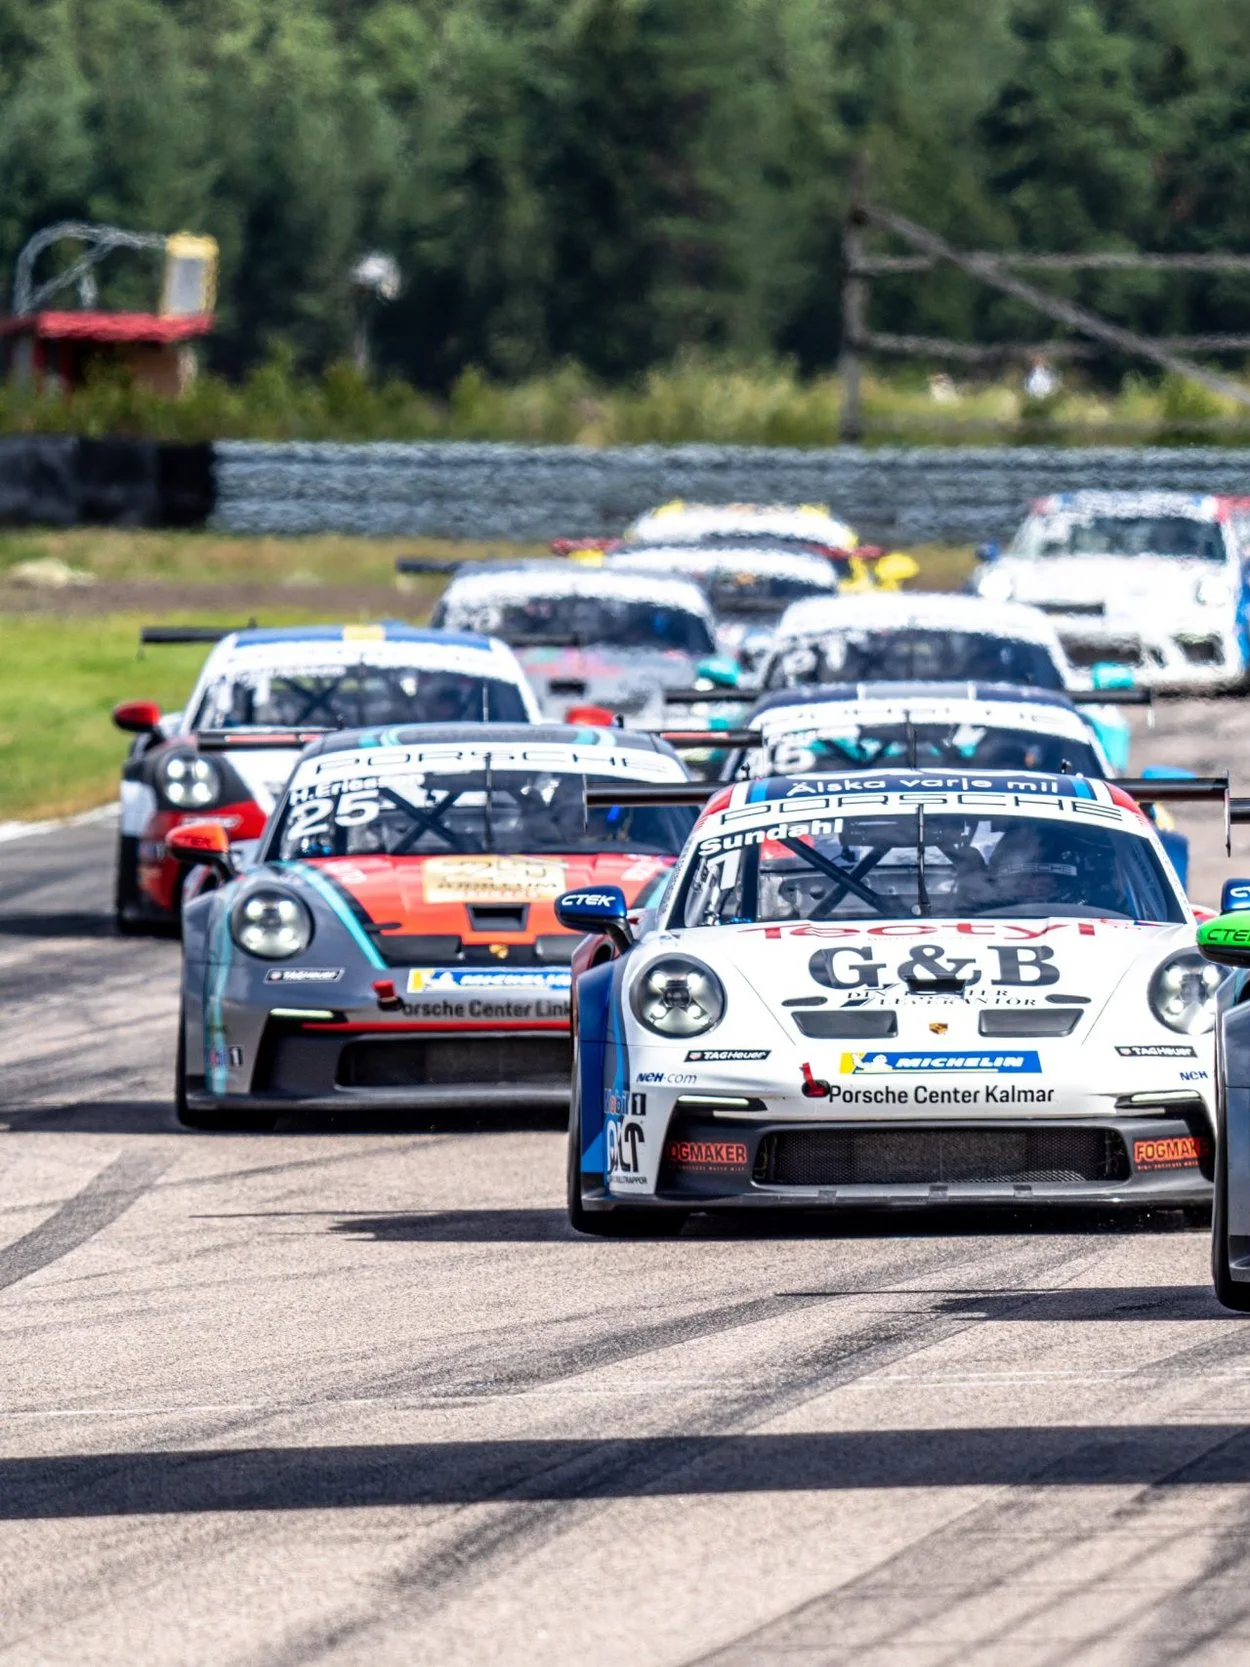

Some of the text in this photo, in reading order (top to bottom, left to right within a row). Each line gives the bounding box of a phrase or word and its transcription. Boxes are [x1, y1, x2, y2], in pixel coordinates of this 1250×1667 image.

[786, 776, 1058, 797] Älska varje mil
[288, 789, 380, 840] 25
[720, 792, 1121, 826] PORSCHE
[698, 818, 844, 856] Sundahl
[707, 849, 742, 891] 1
[561, 894, 616, 907] CTEK
[808, 943, 1061, 990] G&B
[468, 999, 533, 1018] Center
[535, 999, 571, 1017] Link
[895, 1056, 1025, 1068] MICHELIN
[828, 1084, 1055, 1104] Porsche Center Kalmar
[670, 1143, 746, 1163] OGMAKER
